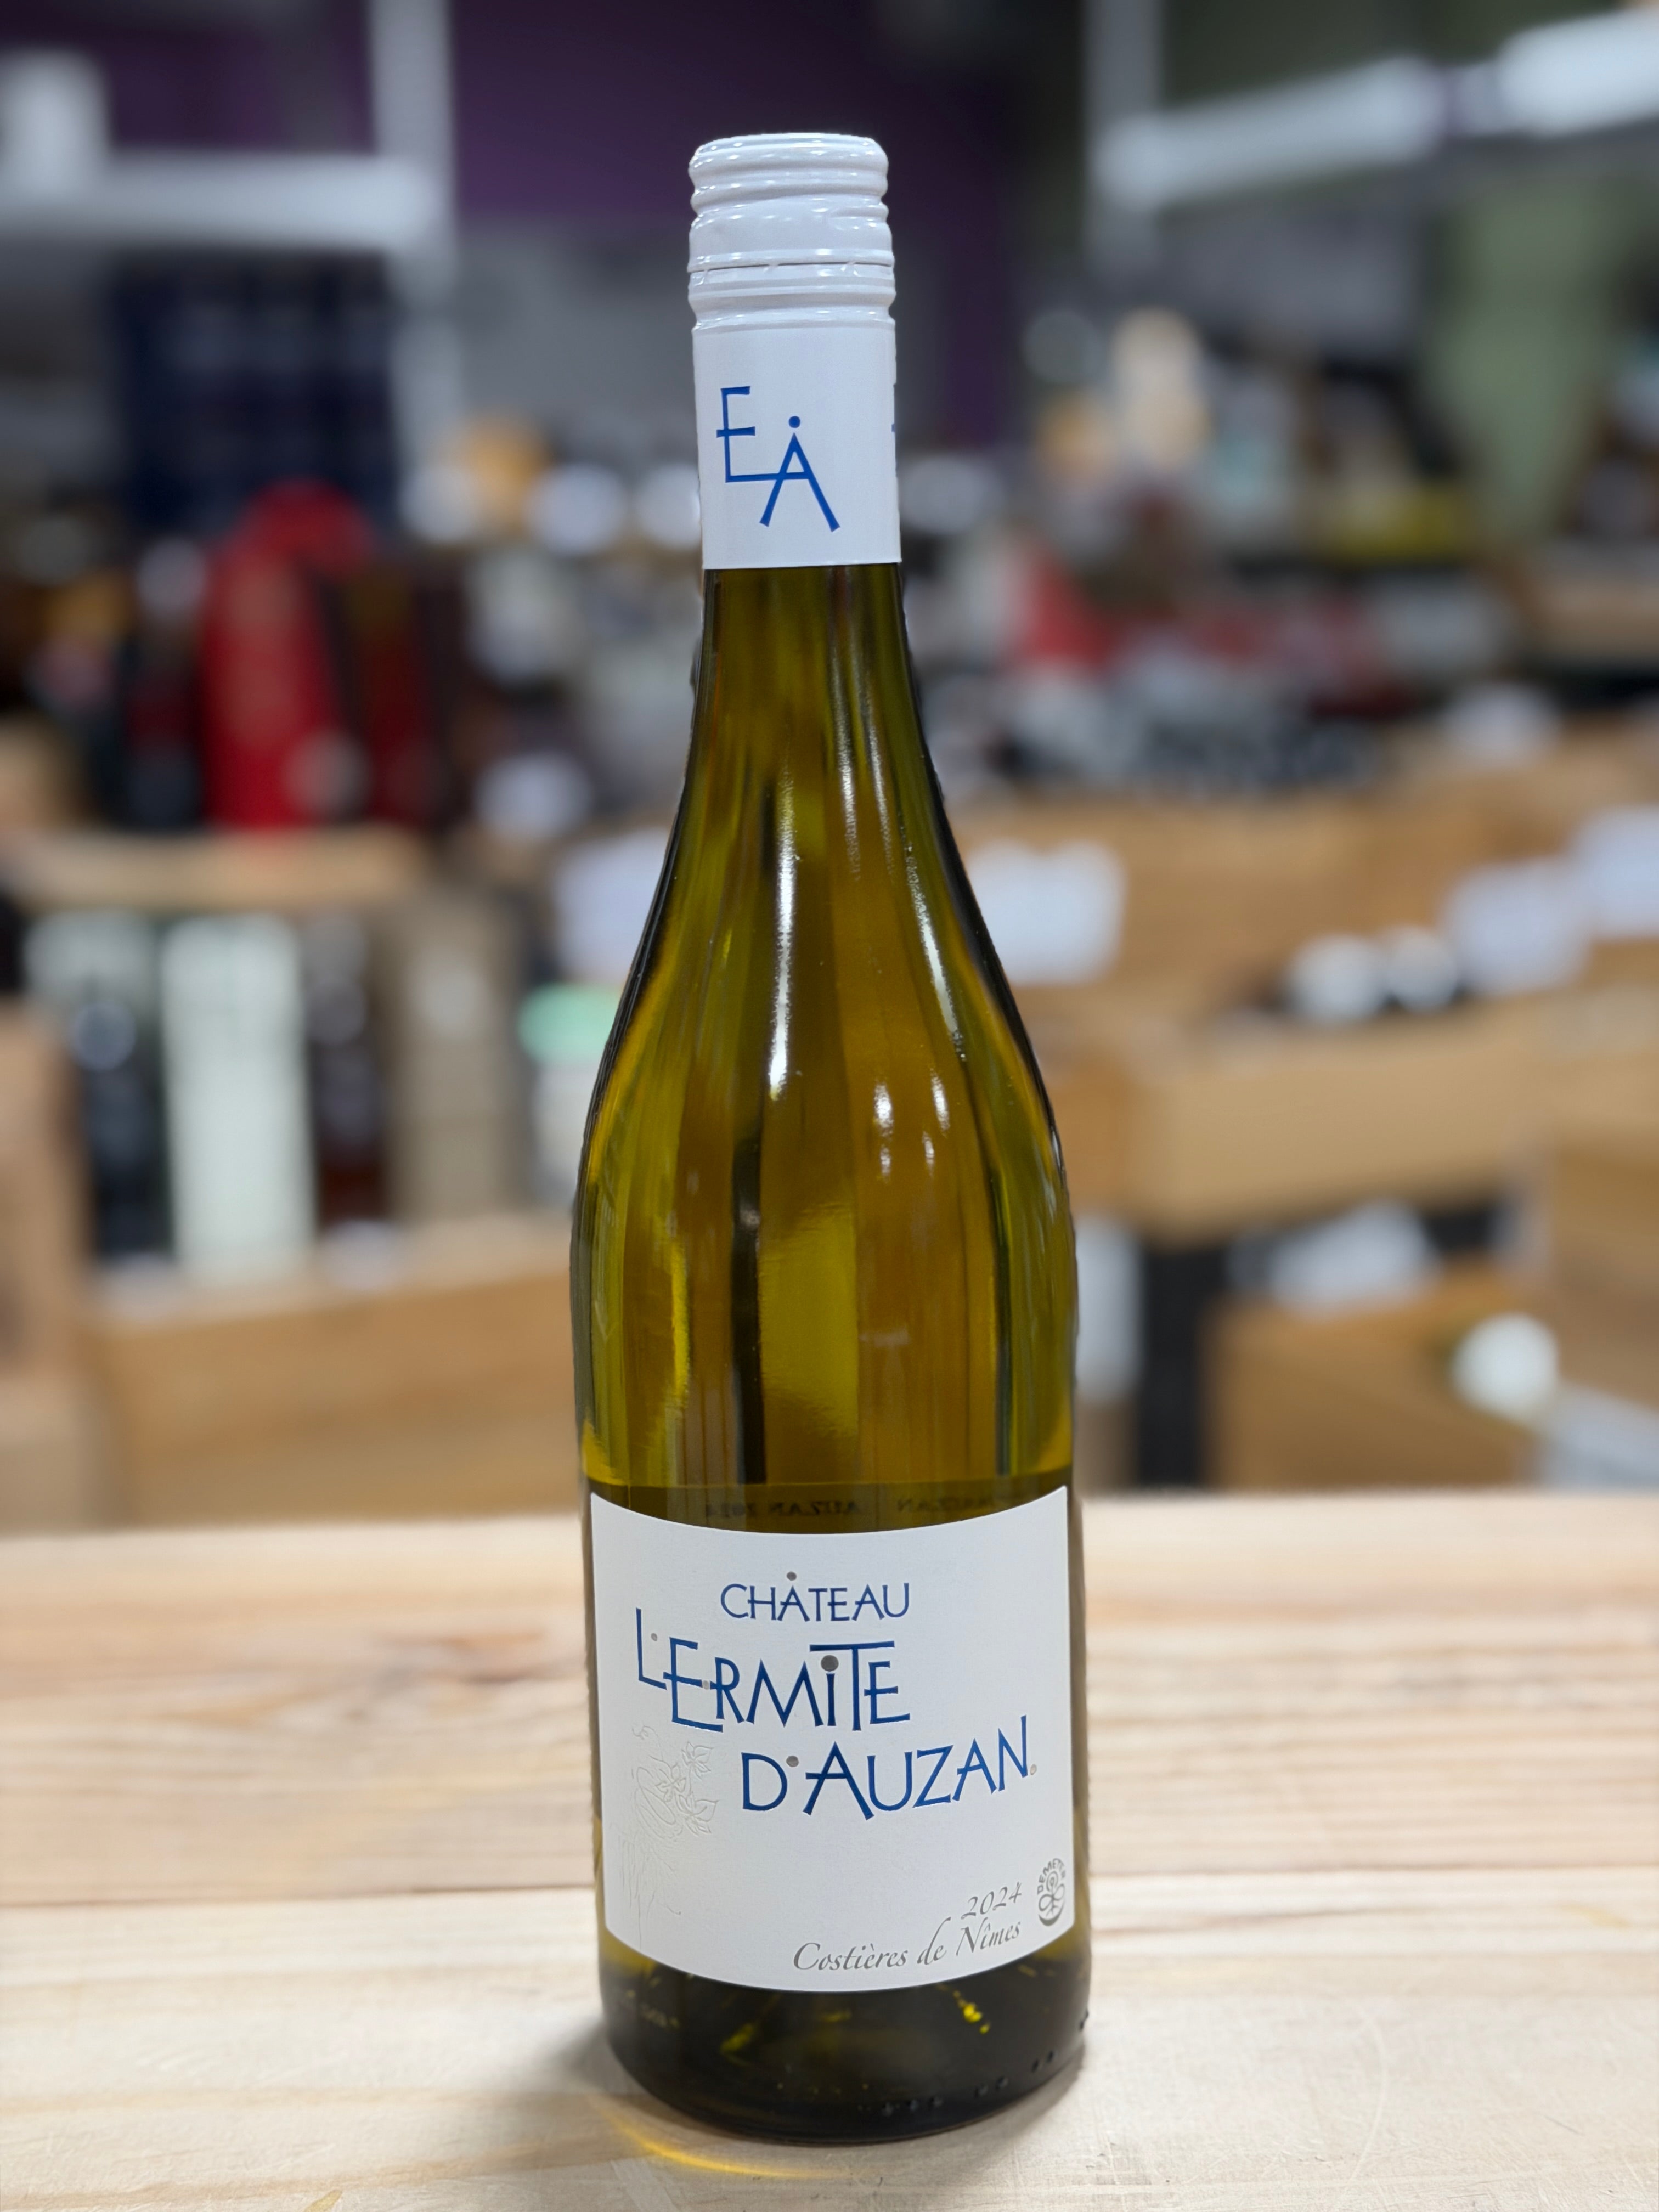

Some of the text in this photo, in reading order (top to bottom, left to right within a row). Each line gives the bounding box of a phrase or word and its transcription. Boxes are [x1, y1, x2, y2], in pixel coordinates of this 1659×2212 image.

[962, 1882, 1022, 1919] 2024
[793, 1917, 1021, 1970] Costières de Nîmes
